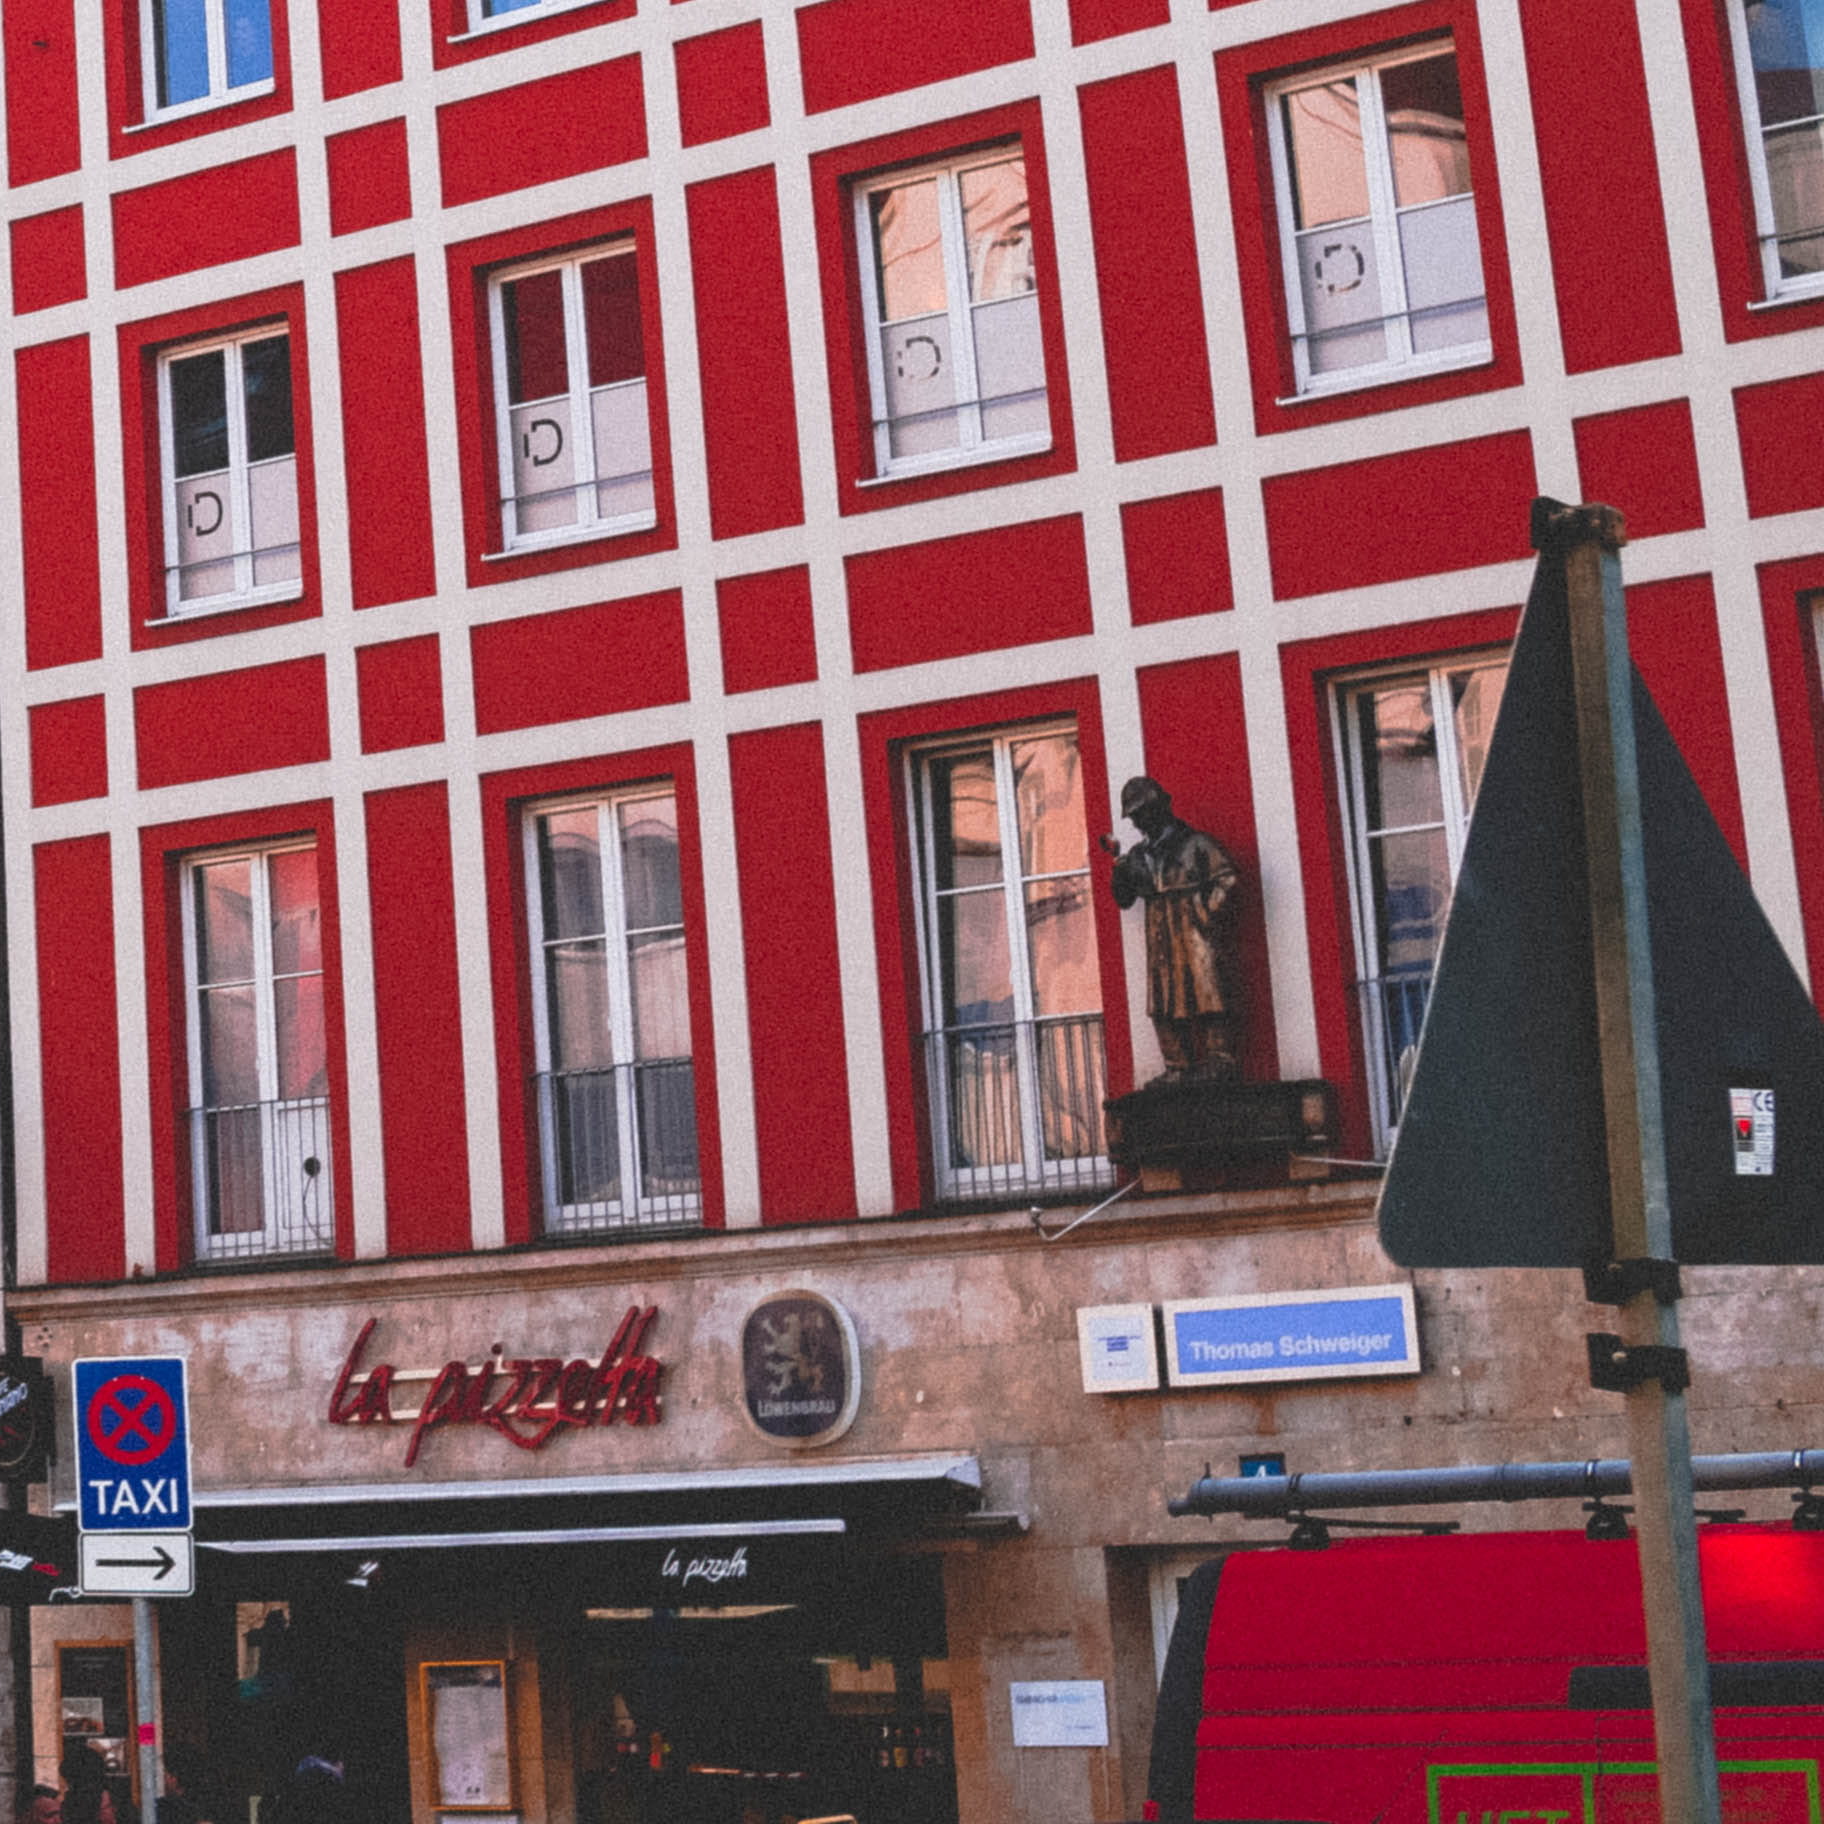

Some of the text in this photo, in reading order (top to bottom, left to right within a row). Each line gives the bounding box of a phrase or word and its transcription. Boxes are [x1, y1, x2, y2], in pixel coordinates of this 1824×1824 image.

[1189, 1331, 1393, 1362] Thomas Schweiger
[405, 1306, 661, 1468] pizzetta
[89, 1479, 178, 1515] TAXI
